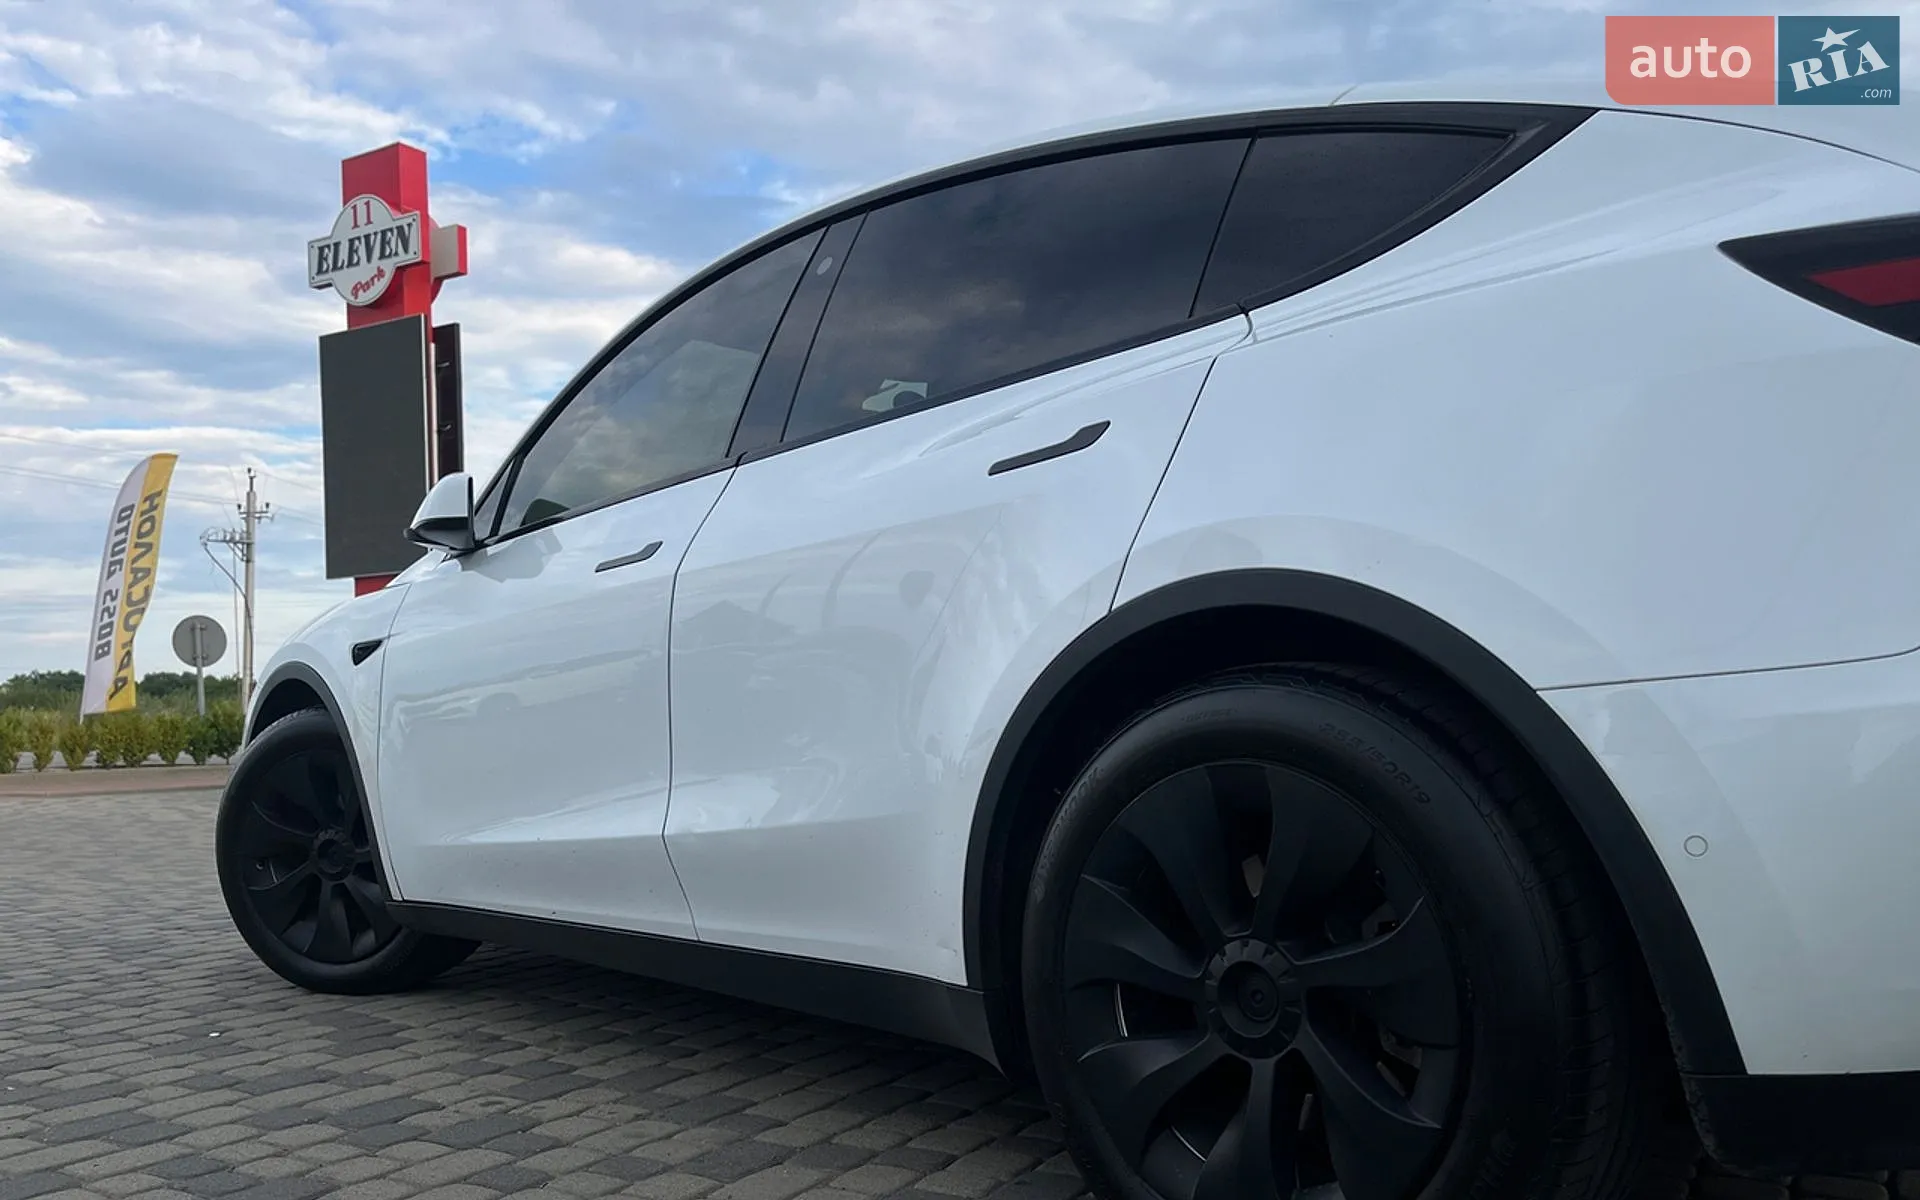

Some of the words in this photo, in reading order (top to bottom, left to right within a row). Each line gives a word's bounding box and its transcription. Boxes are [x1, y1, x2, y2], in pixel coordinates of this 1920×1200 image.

[351, 200, 373, 229] 11
[316, 223, 413, 275] ELEVEN
[351, 265, 385, 299] Park
